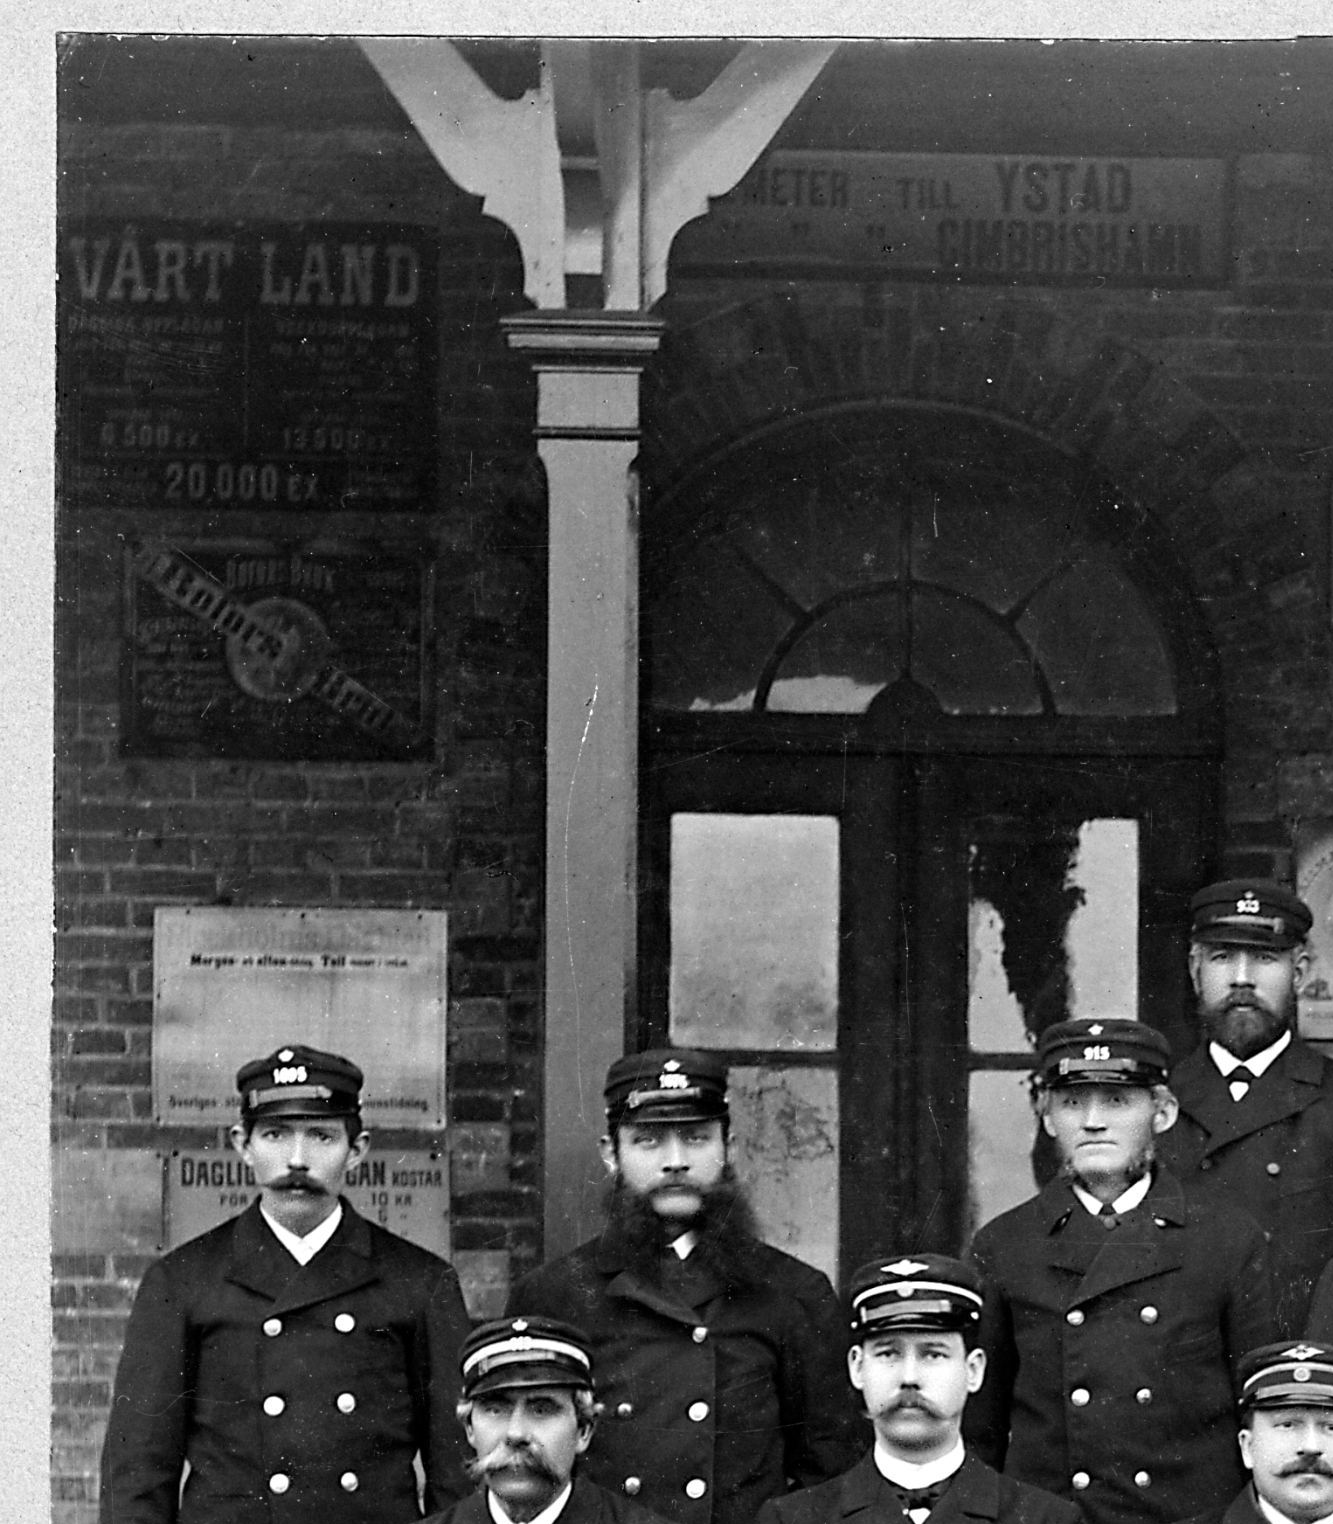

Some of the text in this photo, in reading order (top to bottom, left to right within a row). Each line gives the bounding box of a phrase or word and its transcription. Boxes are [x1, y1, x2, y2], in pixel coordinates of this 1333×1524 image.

[898, 176, 958, 211] TILL
[994, 160, 1133, 214] YSTAD
[68, 223, 421, 308] VÅRT LAND
